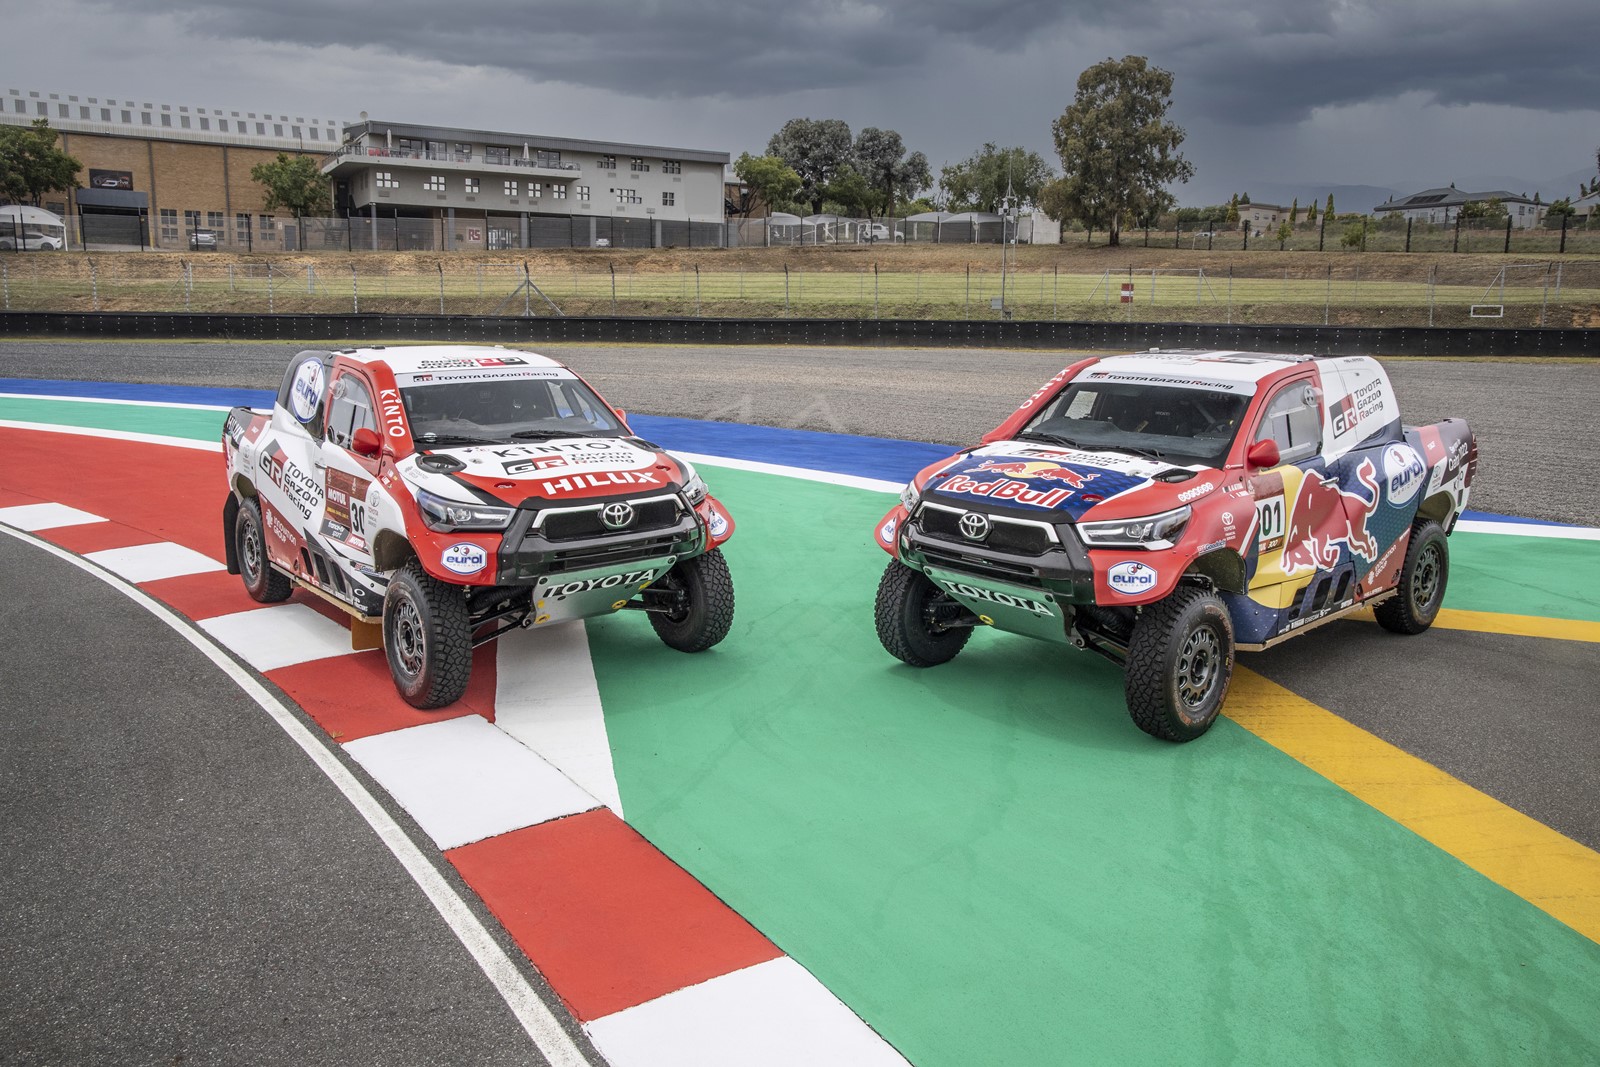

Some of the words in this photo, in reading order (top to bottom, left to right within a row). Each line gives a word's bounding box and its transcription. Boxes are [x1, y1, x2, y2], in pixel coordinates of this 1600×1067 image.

[468, 229, 480, 241] RS
[295, 378, 320, 408] eurol
[1149, 377, 1191, 385] GAZOO
[1191, 381, 1235, 390] Racing
[1354, 378, 1382, 400] TOYOTA
[1357, 389, 1382, 410] GAZOO
[1359, 400, 1384, 421] Racing
[1332, 407, 1358, 437] GR
[259, 450, 284, 488] GR
[286, 461, 324, 499] TOYOTA
[505, 458, 567, 474] GR
[1391, 453, 1424, 492] eurol
[284, 473, 318, 507] GAZOO
[327, 487, 346, 506] MOTUL
[541, 471, 660, 496] HILUX
[935, 474, 1010, 496] Red
[989, 480, 1076, 509] Bull
[283, 484, 313, 520] Racing
[273, 515, 297, 546] INNOVATION
[273, 525, 287, 543] GROUP
[1256, 501, 1281, 537] 01
[446, 554, 483, 564] eurol
[546, 568, 655, 598] TOYOTA
[1112, 574, 1152, 584] eurol
[939, 579, 1056, 618] TOYOTA
